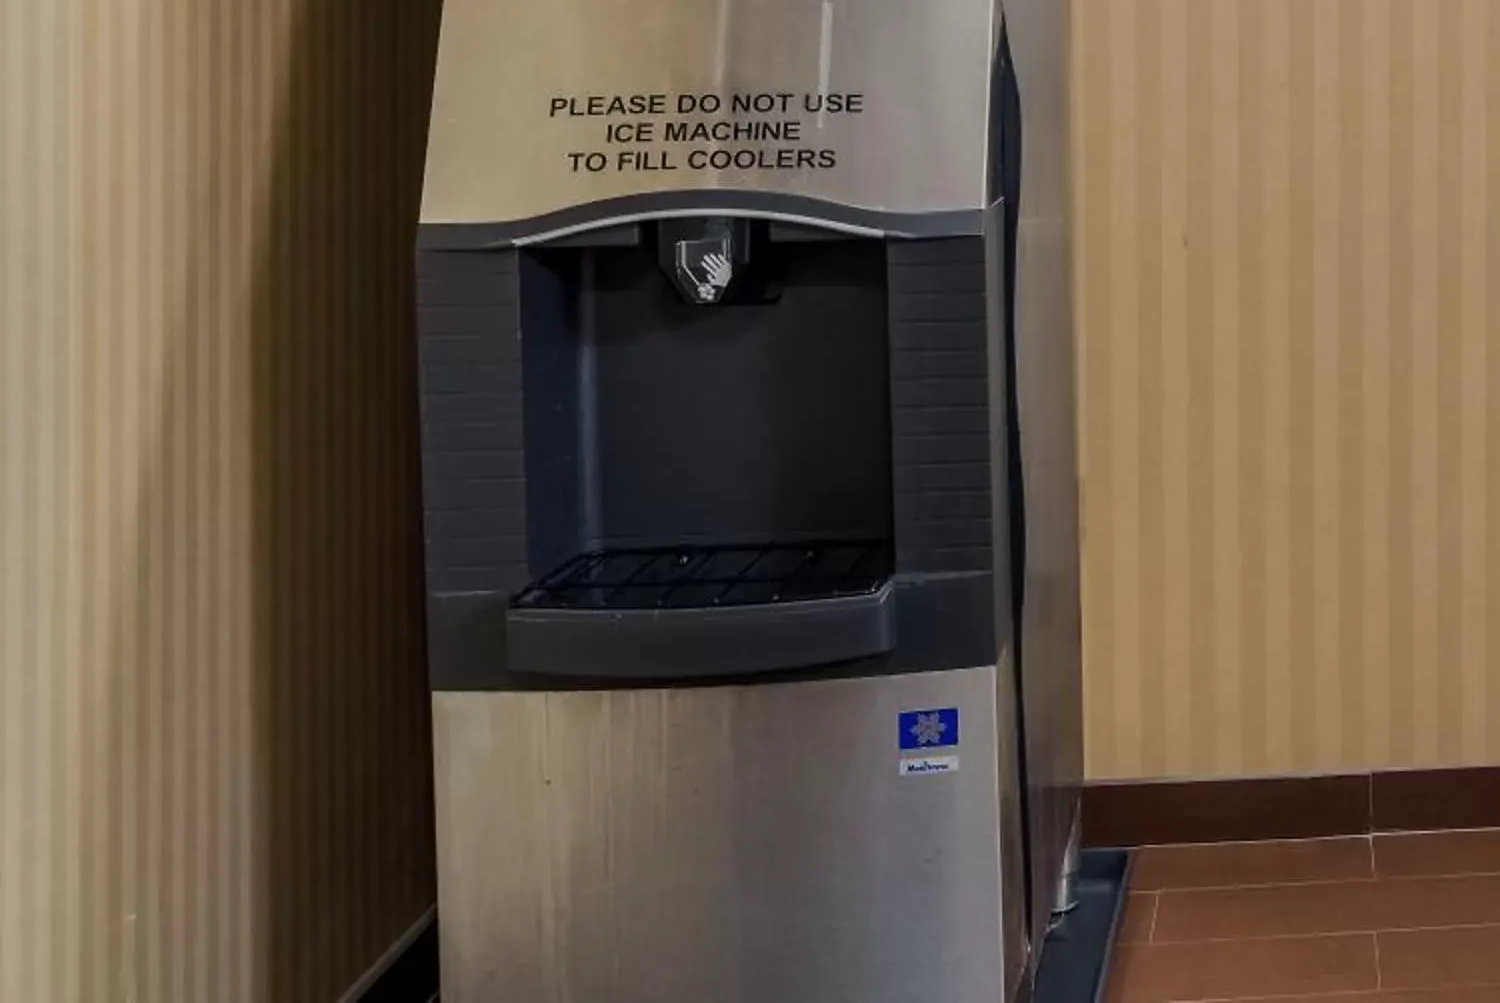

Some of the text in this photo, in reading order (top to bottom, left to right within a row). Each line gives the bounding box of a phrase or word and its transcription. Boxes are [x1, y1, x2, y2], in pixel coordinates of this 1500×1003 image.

[549, 93, 865, 117] PLEASE DO NOT USE
[606, 120, 801, 143] ICE MACHINE
[567, 149, 836, 172] TO FILL COOLERS
